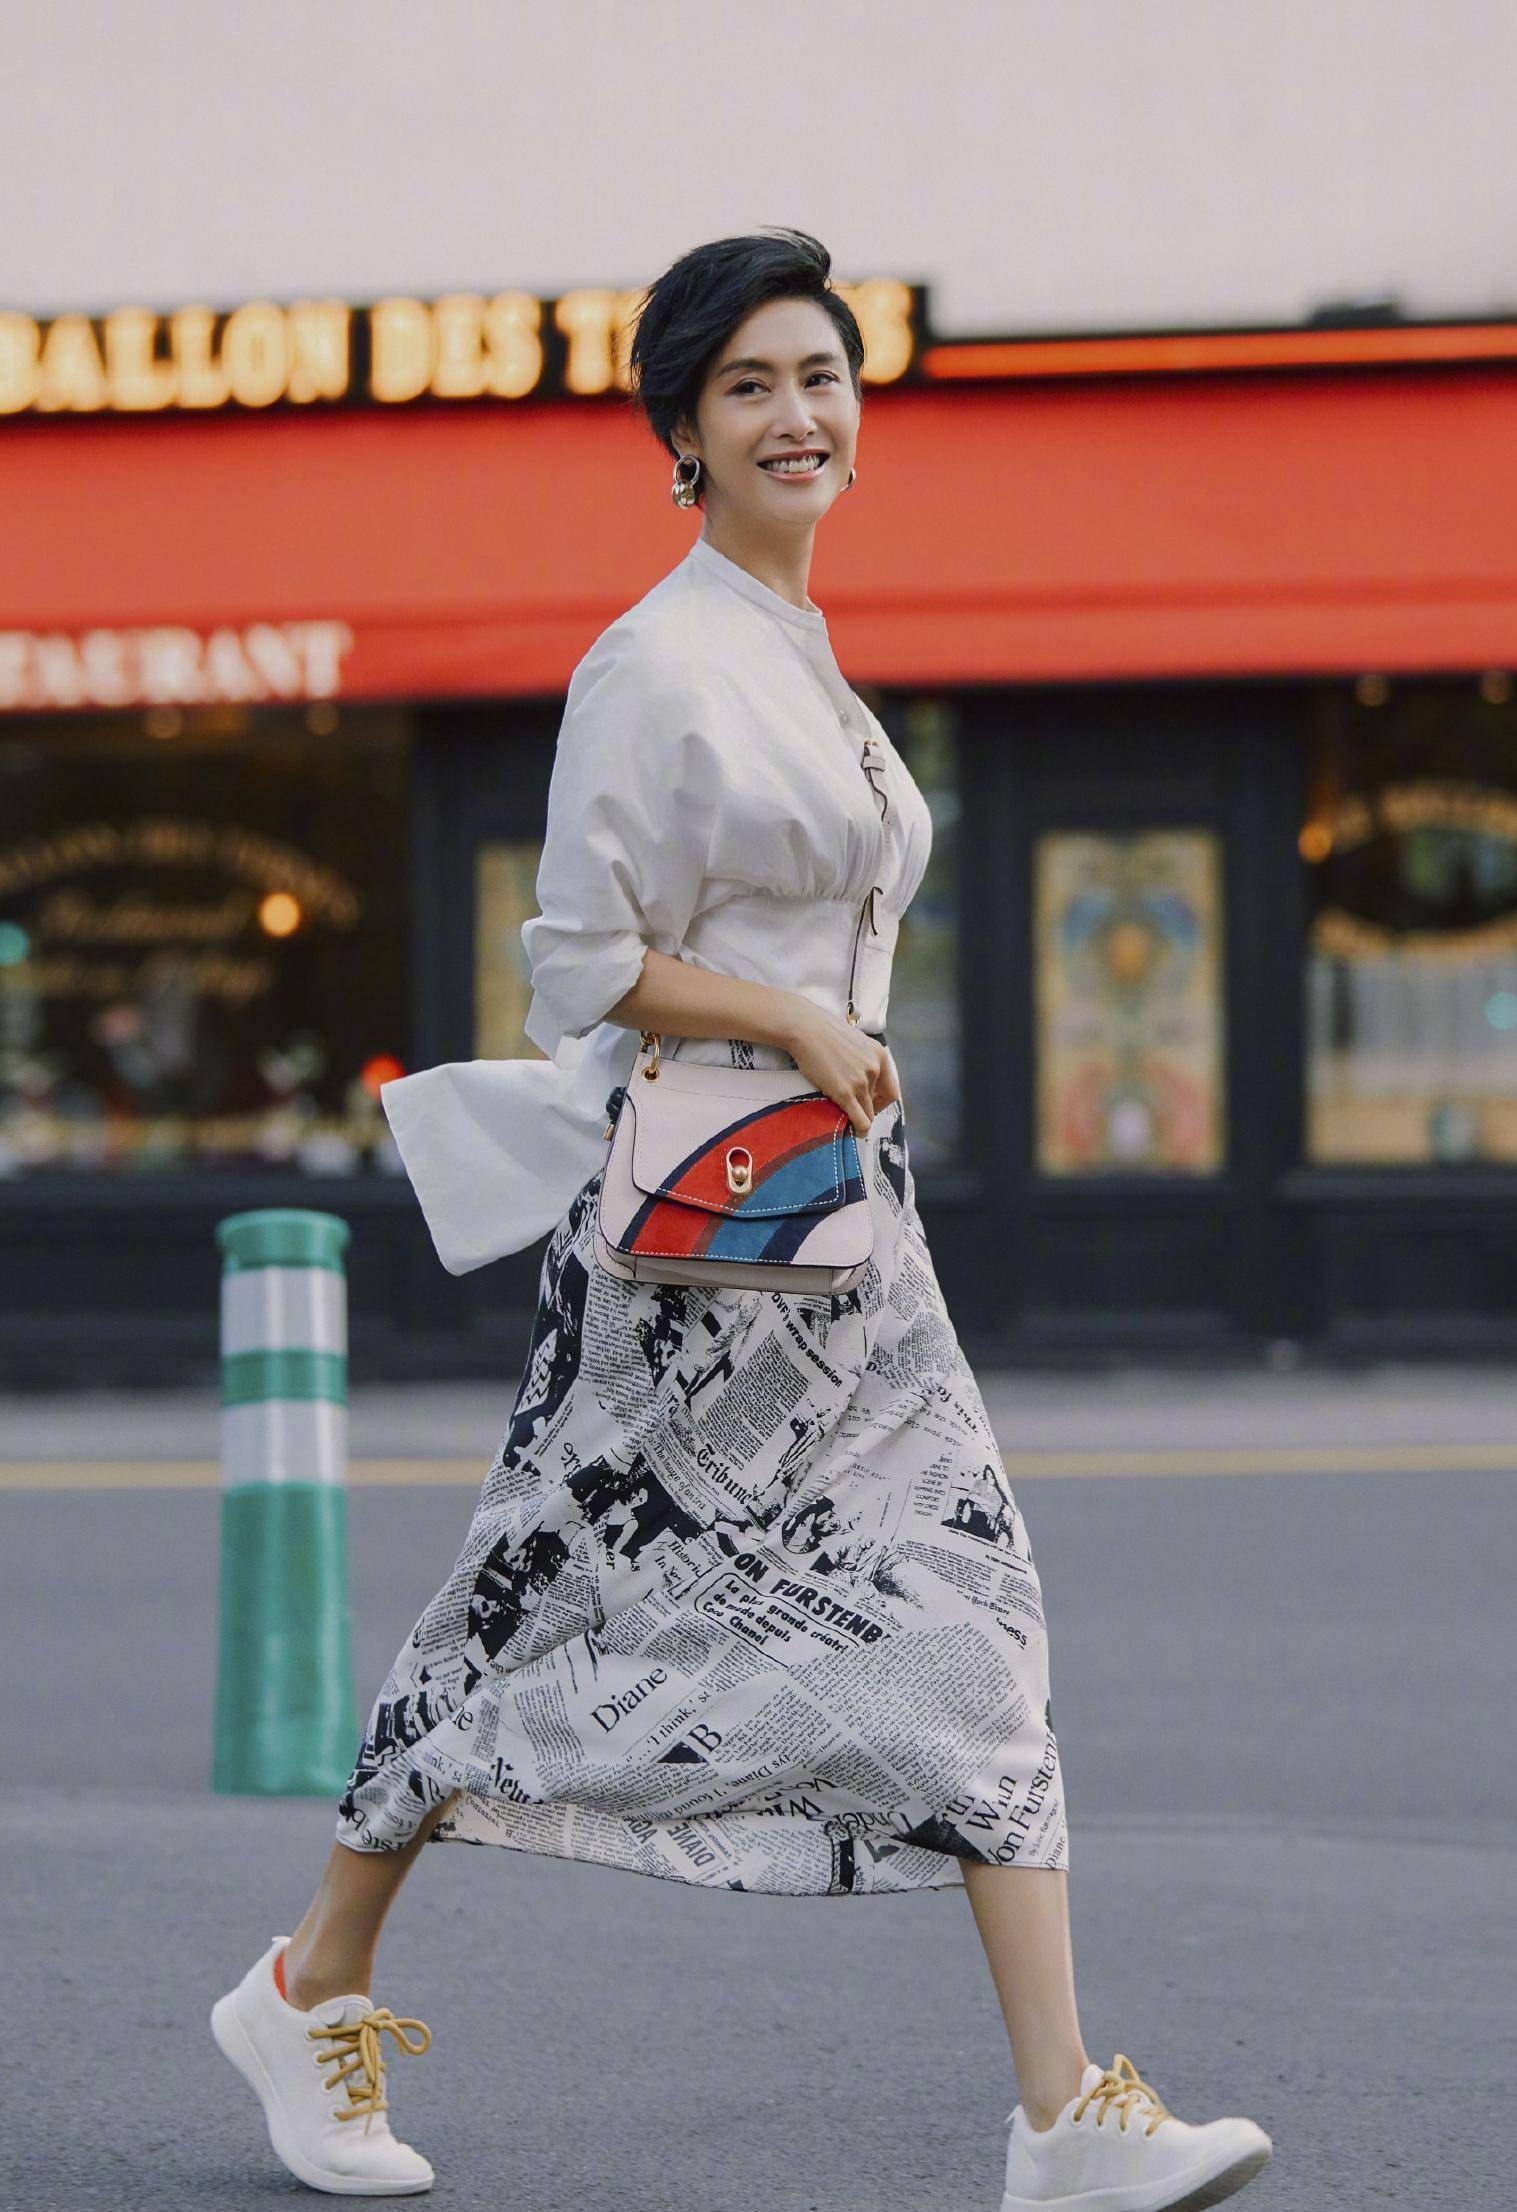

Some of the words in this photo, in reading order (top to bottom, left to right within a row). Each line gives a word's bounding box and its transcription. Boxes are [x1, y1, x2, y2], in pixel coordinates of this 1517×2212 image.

[369, 290, 543, 402] DES
[785, 1320, 809, 1350] wrap
[806, 1348, 843, 1387] session
[697, 1444, 752, 1505] Tribune
[725, 1580, 739, 1594] La
[734, 1553, 769, 1583] ON
[730, 1616, 768, 1645] Chanel
[756, 1616, 790, 1642] depuis
[590, 1668, 667, 1733] Diane
